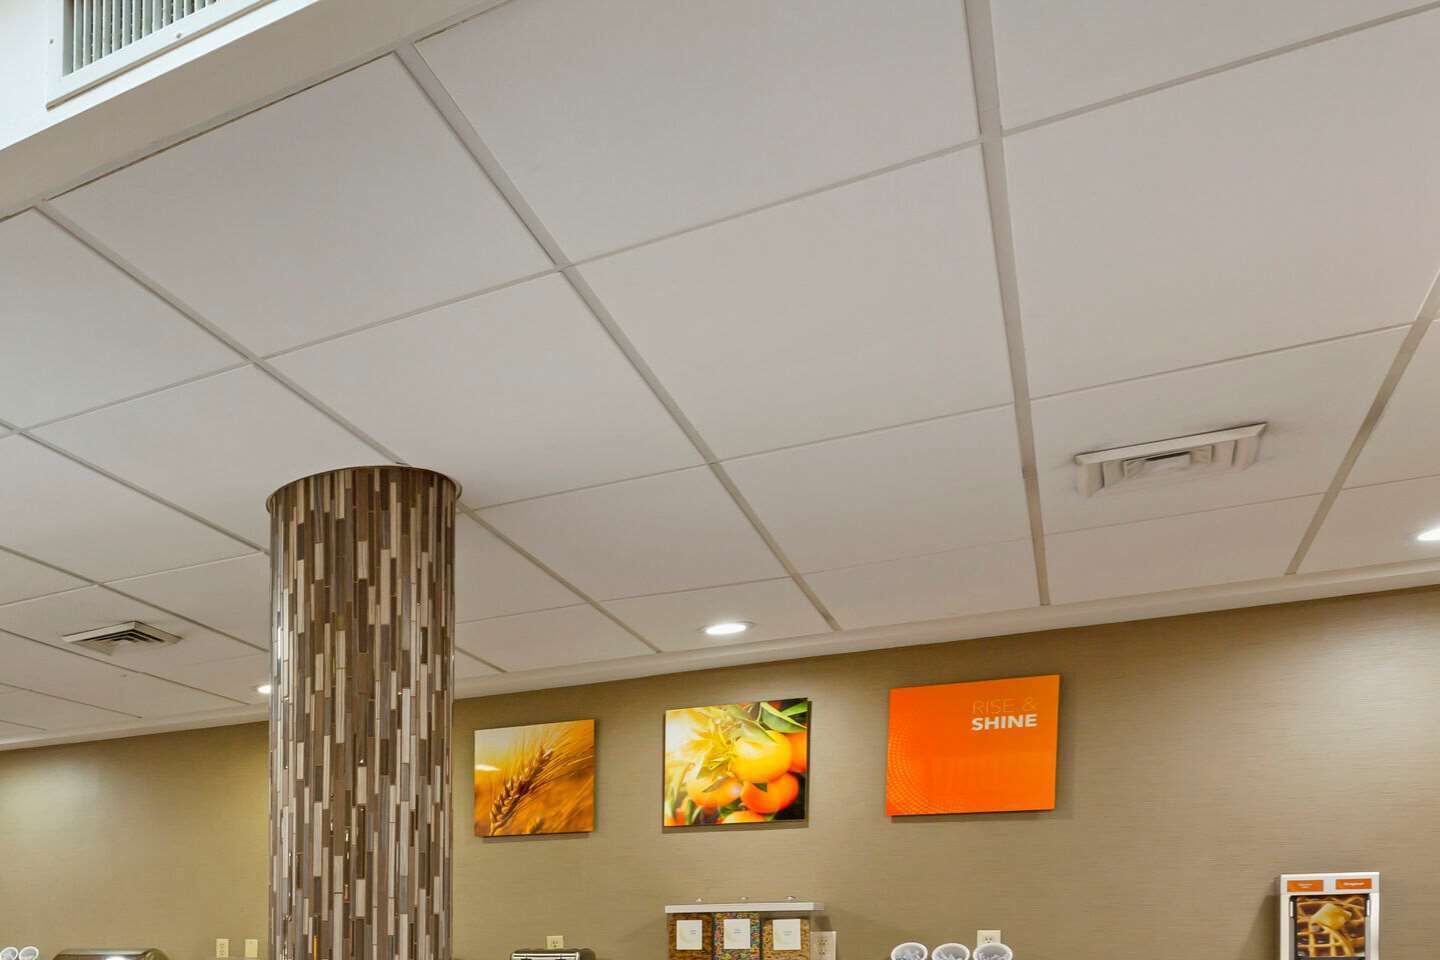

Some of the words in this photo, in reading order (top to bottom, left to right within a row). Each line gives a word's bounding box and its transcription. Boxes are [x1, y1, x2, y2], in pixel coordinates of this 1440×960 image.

[972, 697, 1017, 715] RISE
[1023, 696, 1039, 712] &
[971, 713, 1038, 731] SHINE
